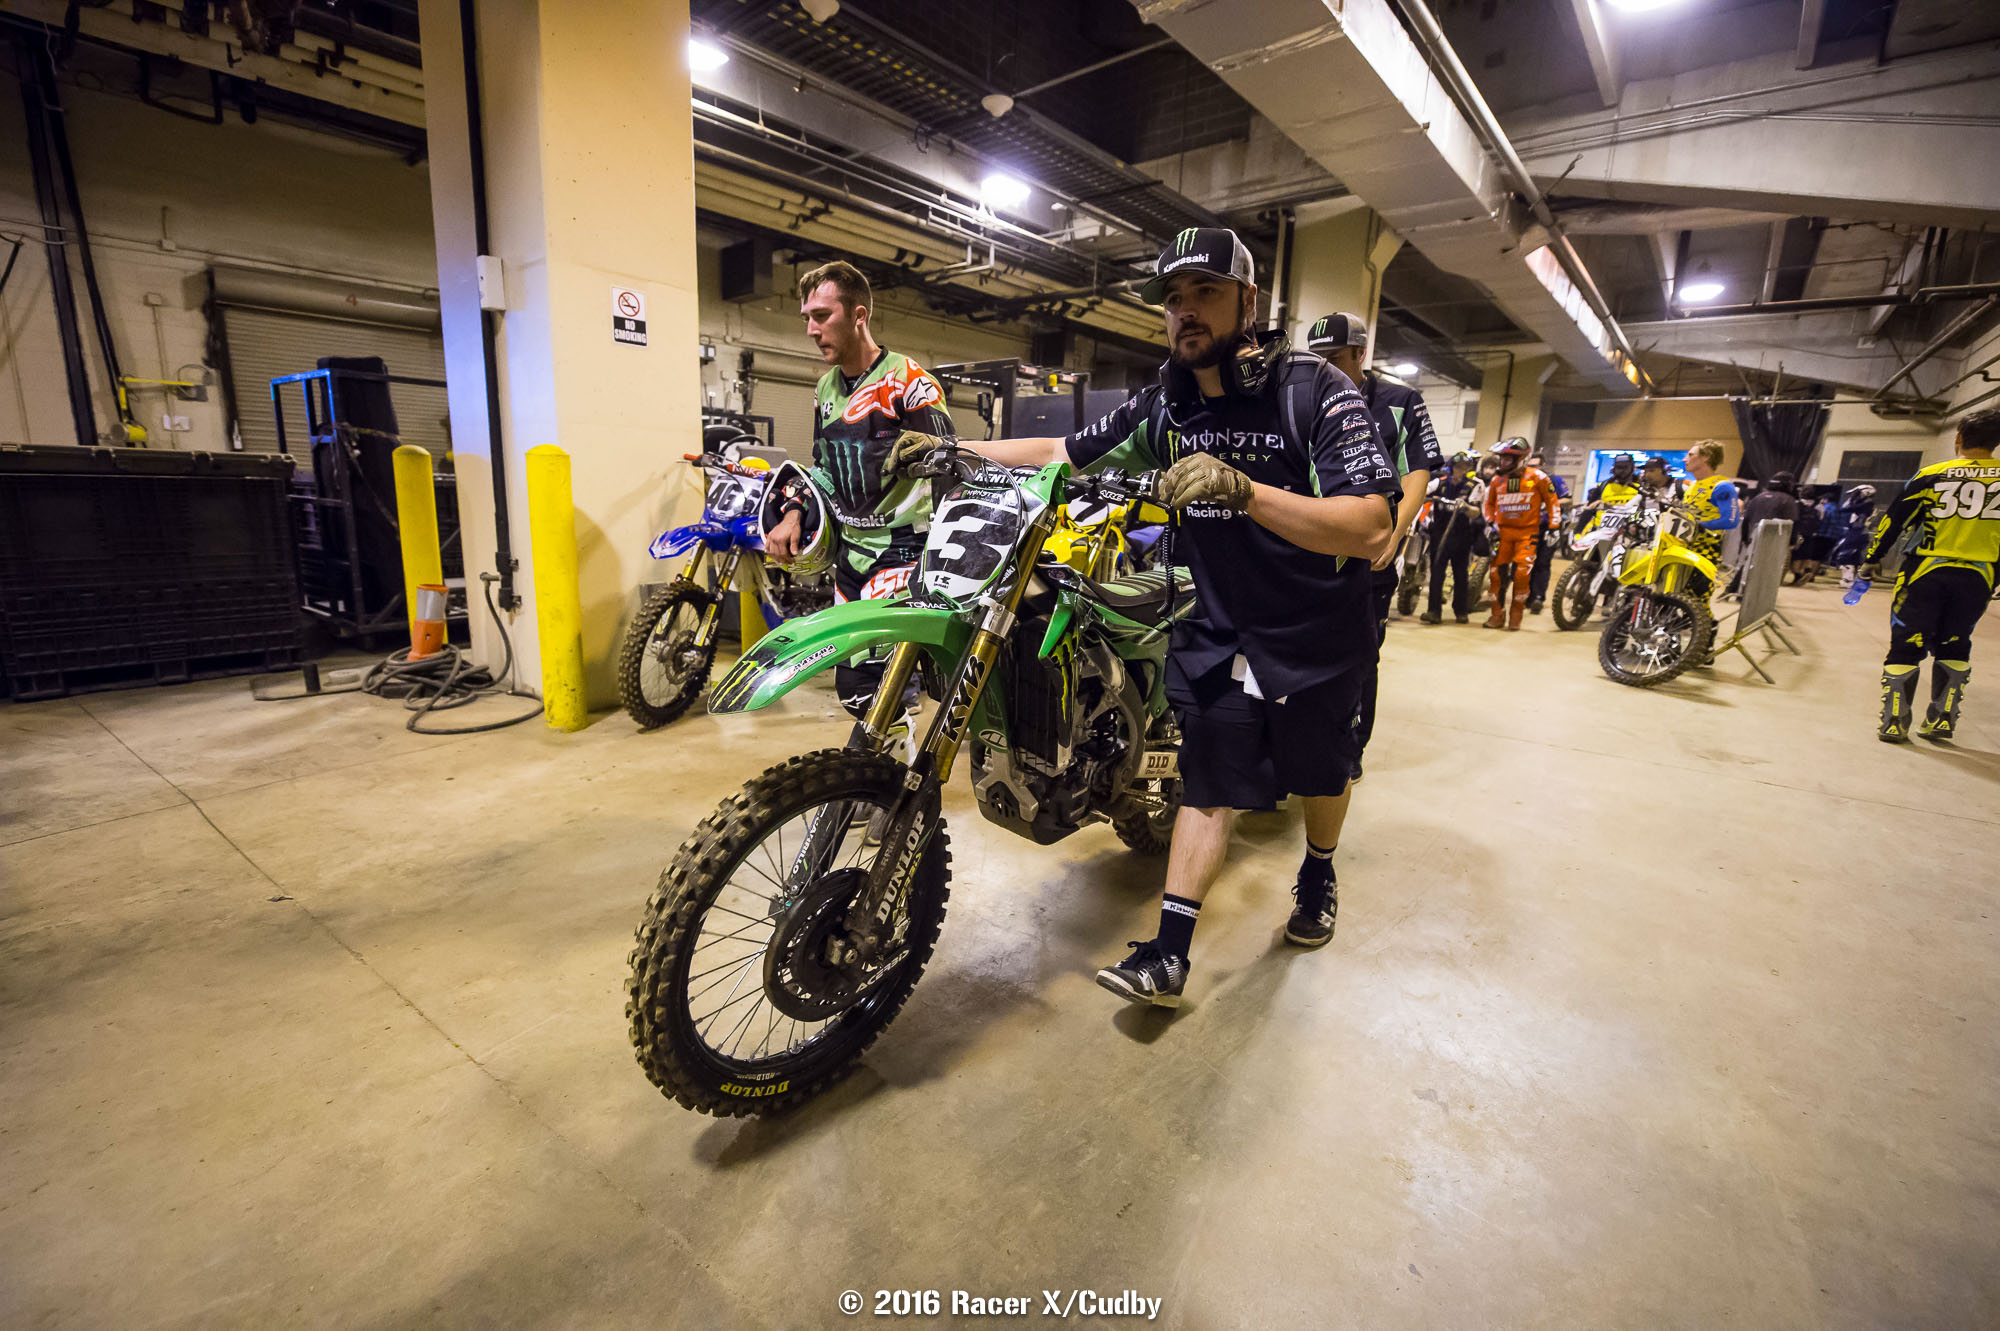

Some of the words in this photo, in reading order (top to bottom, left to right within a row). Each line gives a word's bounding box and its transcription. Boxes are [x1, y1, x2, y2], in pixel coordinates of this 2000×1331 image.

[1163, 253, 1210, 273] Kawasaki
[625, 319, 636, 331] NO
[614, 328, 647, 343] SMOKING
[1100, 489, 1124, 502] ARC
[1931, 481, 2000, 519] 392
[1186, 505, 1232, 520] Racing
[1670, 517, 1693, 541] 12
[926, 503, 1020, 581] 3
[905, 601, 949, 610] TOMAC
[1147, 755, 1169, 768] DID
[875, 810, 924, 925] DUNLOP
[720, 1080, 790, 1097] DUNLOP
